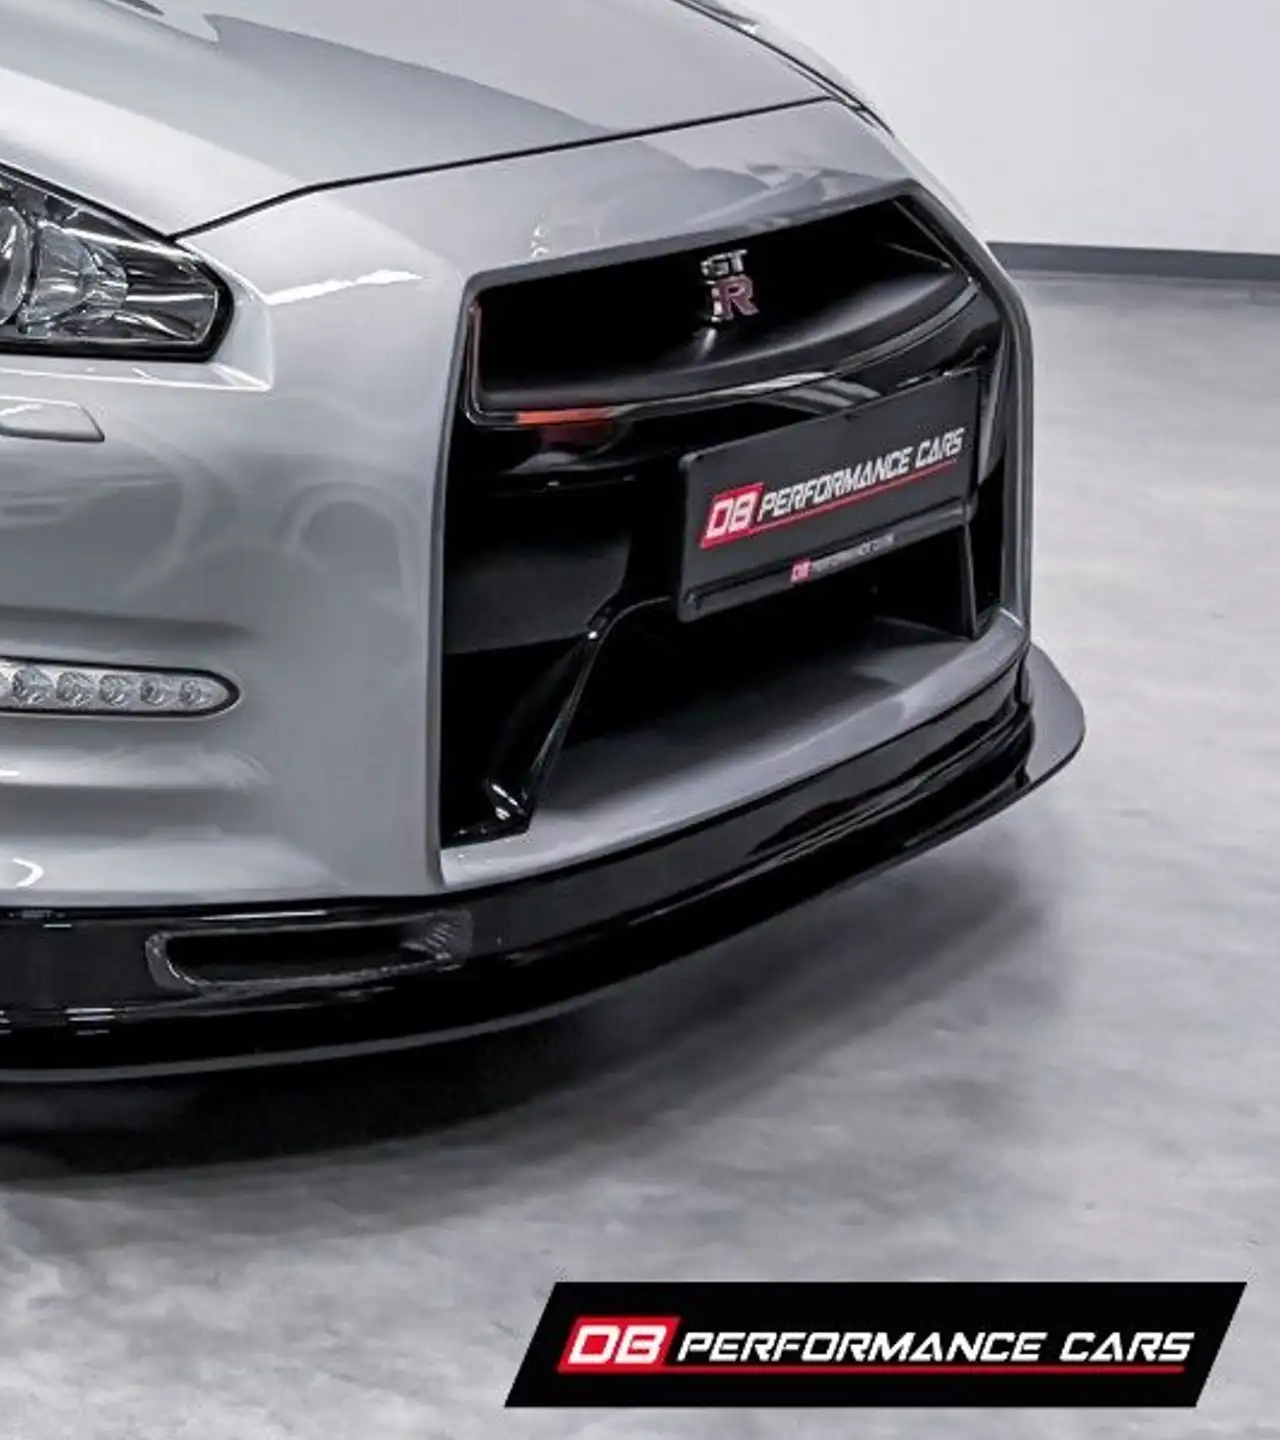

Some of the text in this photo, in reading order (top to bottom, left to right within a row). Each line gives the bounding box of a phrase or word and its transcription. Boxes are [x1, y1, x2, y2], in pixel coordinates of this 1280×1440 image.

[703, 427, 966, 540] DB PERFORMANCE CARS
